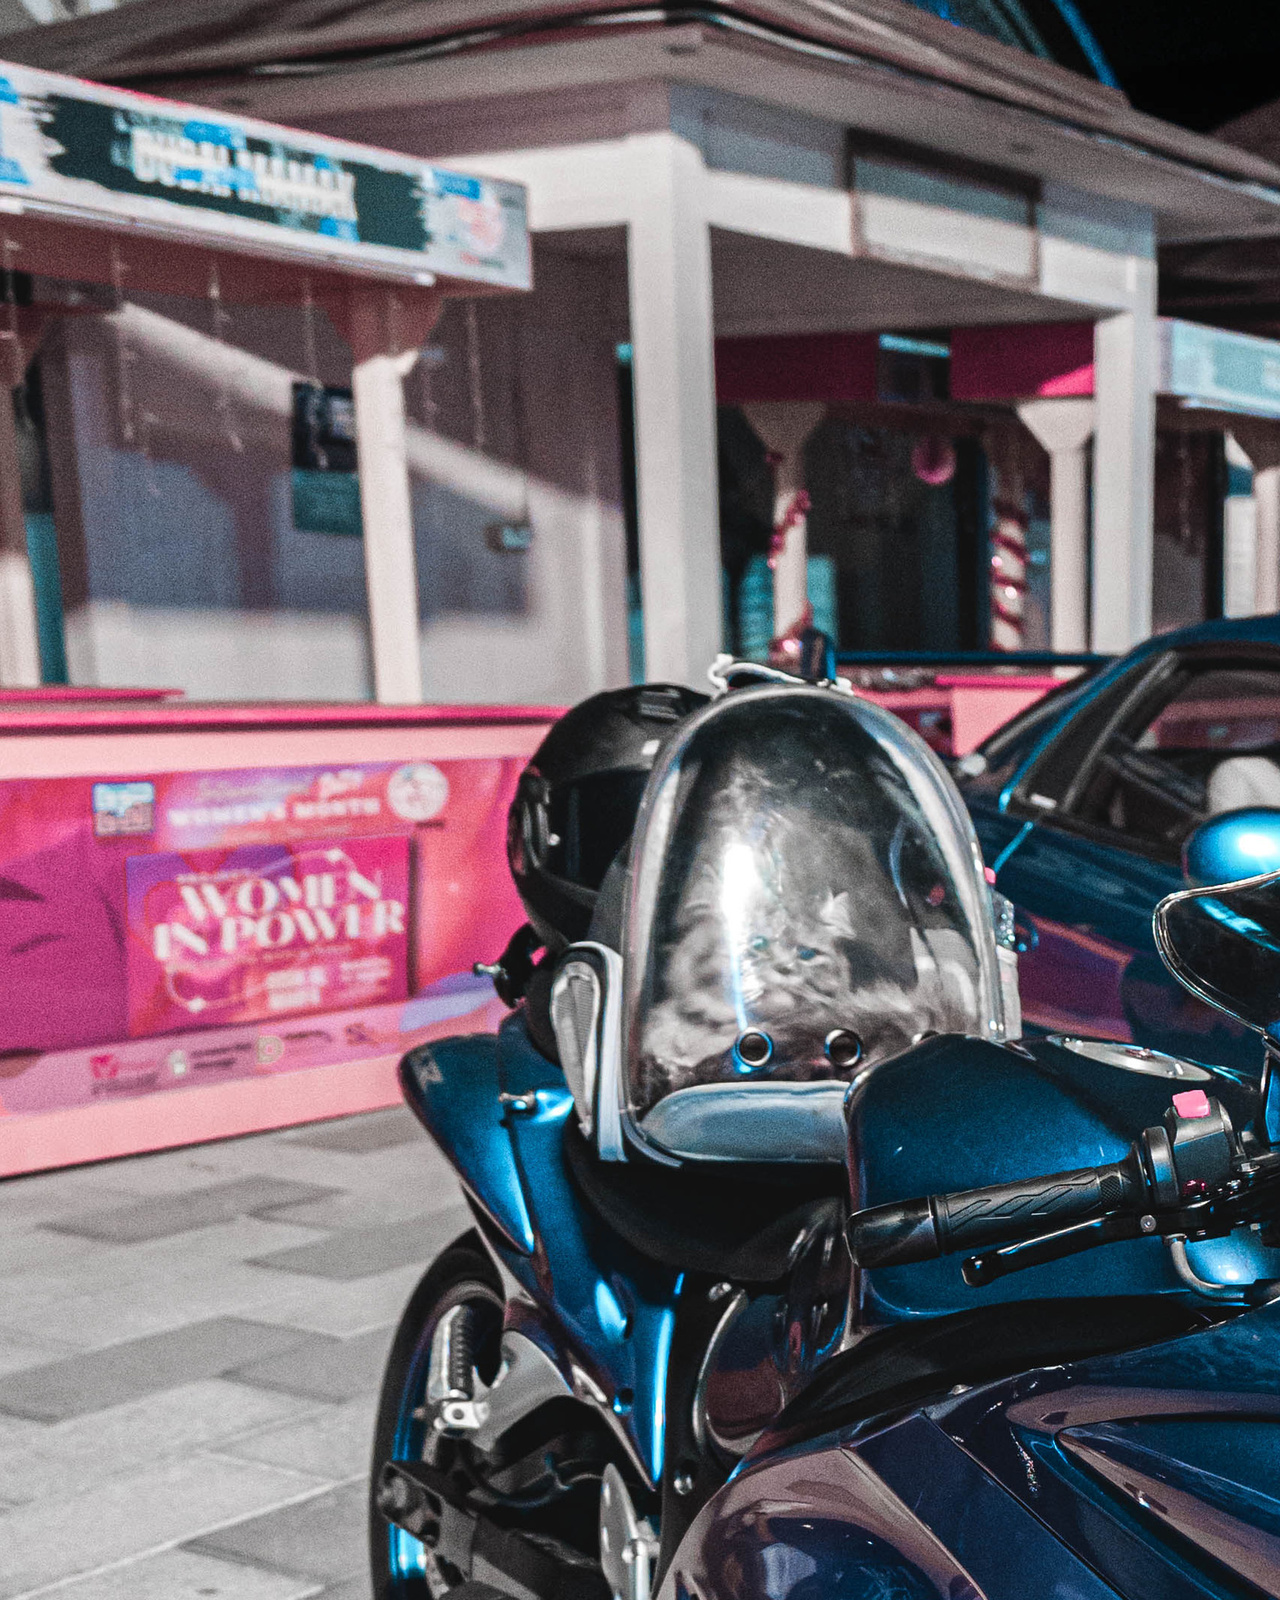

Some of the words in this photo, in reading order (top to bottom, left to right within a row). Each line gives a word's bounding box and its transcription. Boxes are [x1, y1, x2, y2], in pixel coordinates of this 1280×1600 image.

[180, 870, 382, 922] WOMEN
[153, 921, 209, 961] IN
[220, 899, 405, 952] POWER
